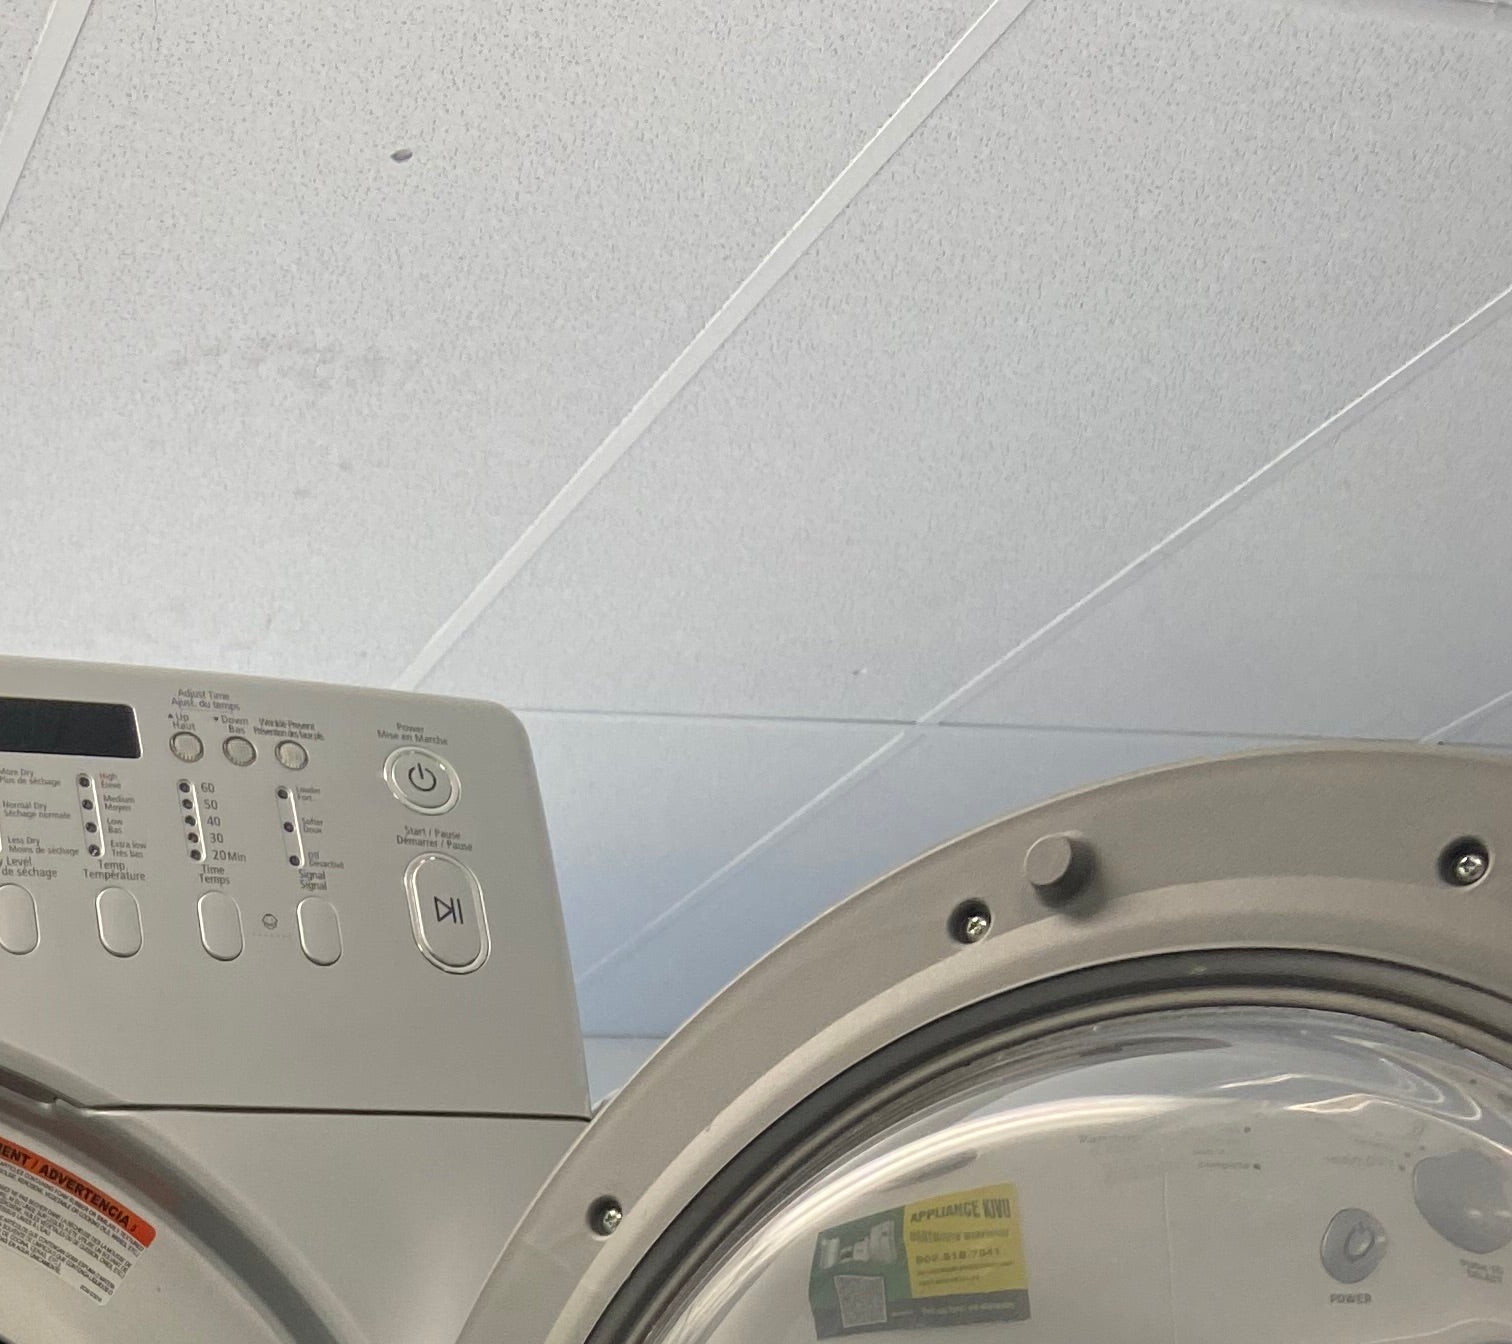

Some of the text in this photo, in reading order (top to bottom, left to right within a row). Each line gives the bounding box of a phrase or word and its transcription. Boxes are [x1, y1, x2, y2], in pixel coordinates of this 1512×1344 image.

[201, 782, 215, 793] 60
[204, 799, 218, 810] 50
[207, 816, 221, 827] 40
[210, 833, 224, 844] 30
[6, 856, 32, 867] Level
[213, 851, 226, 861] 20
[2, 866, 14, 877] de
[83, 868, 146, 881] Température
[201, 865, 225, 875] Time
[298, 868, 326, 880] Signal
[199, 874, 231, 887] Temps
[39, 1163, 130, 1228] ADVERTENCIA
[911, 1198, 1011, 1222] APPLIANCE KIVU
[1330, 1293, 1372, 1305] POWER
